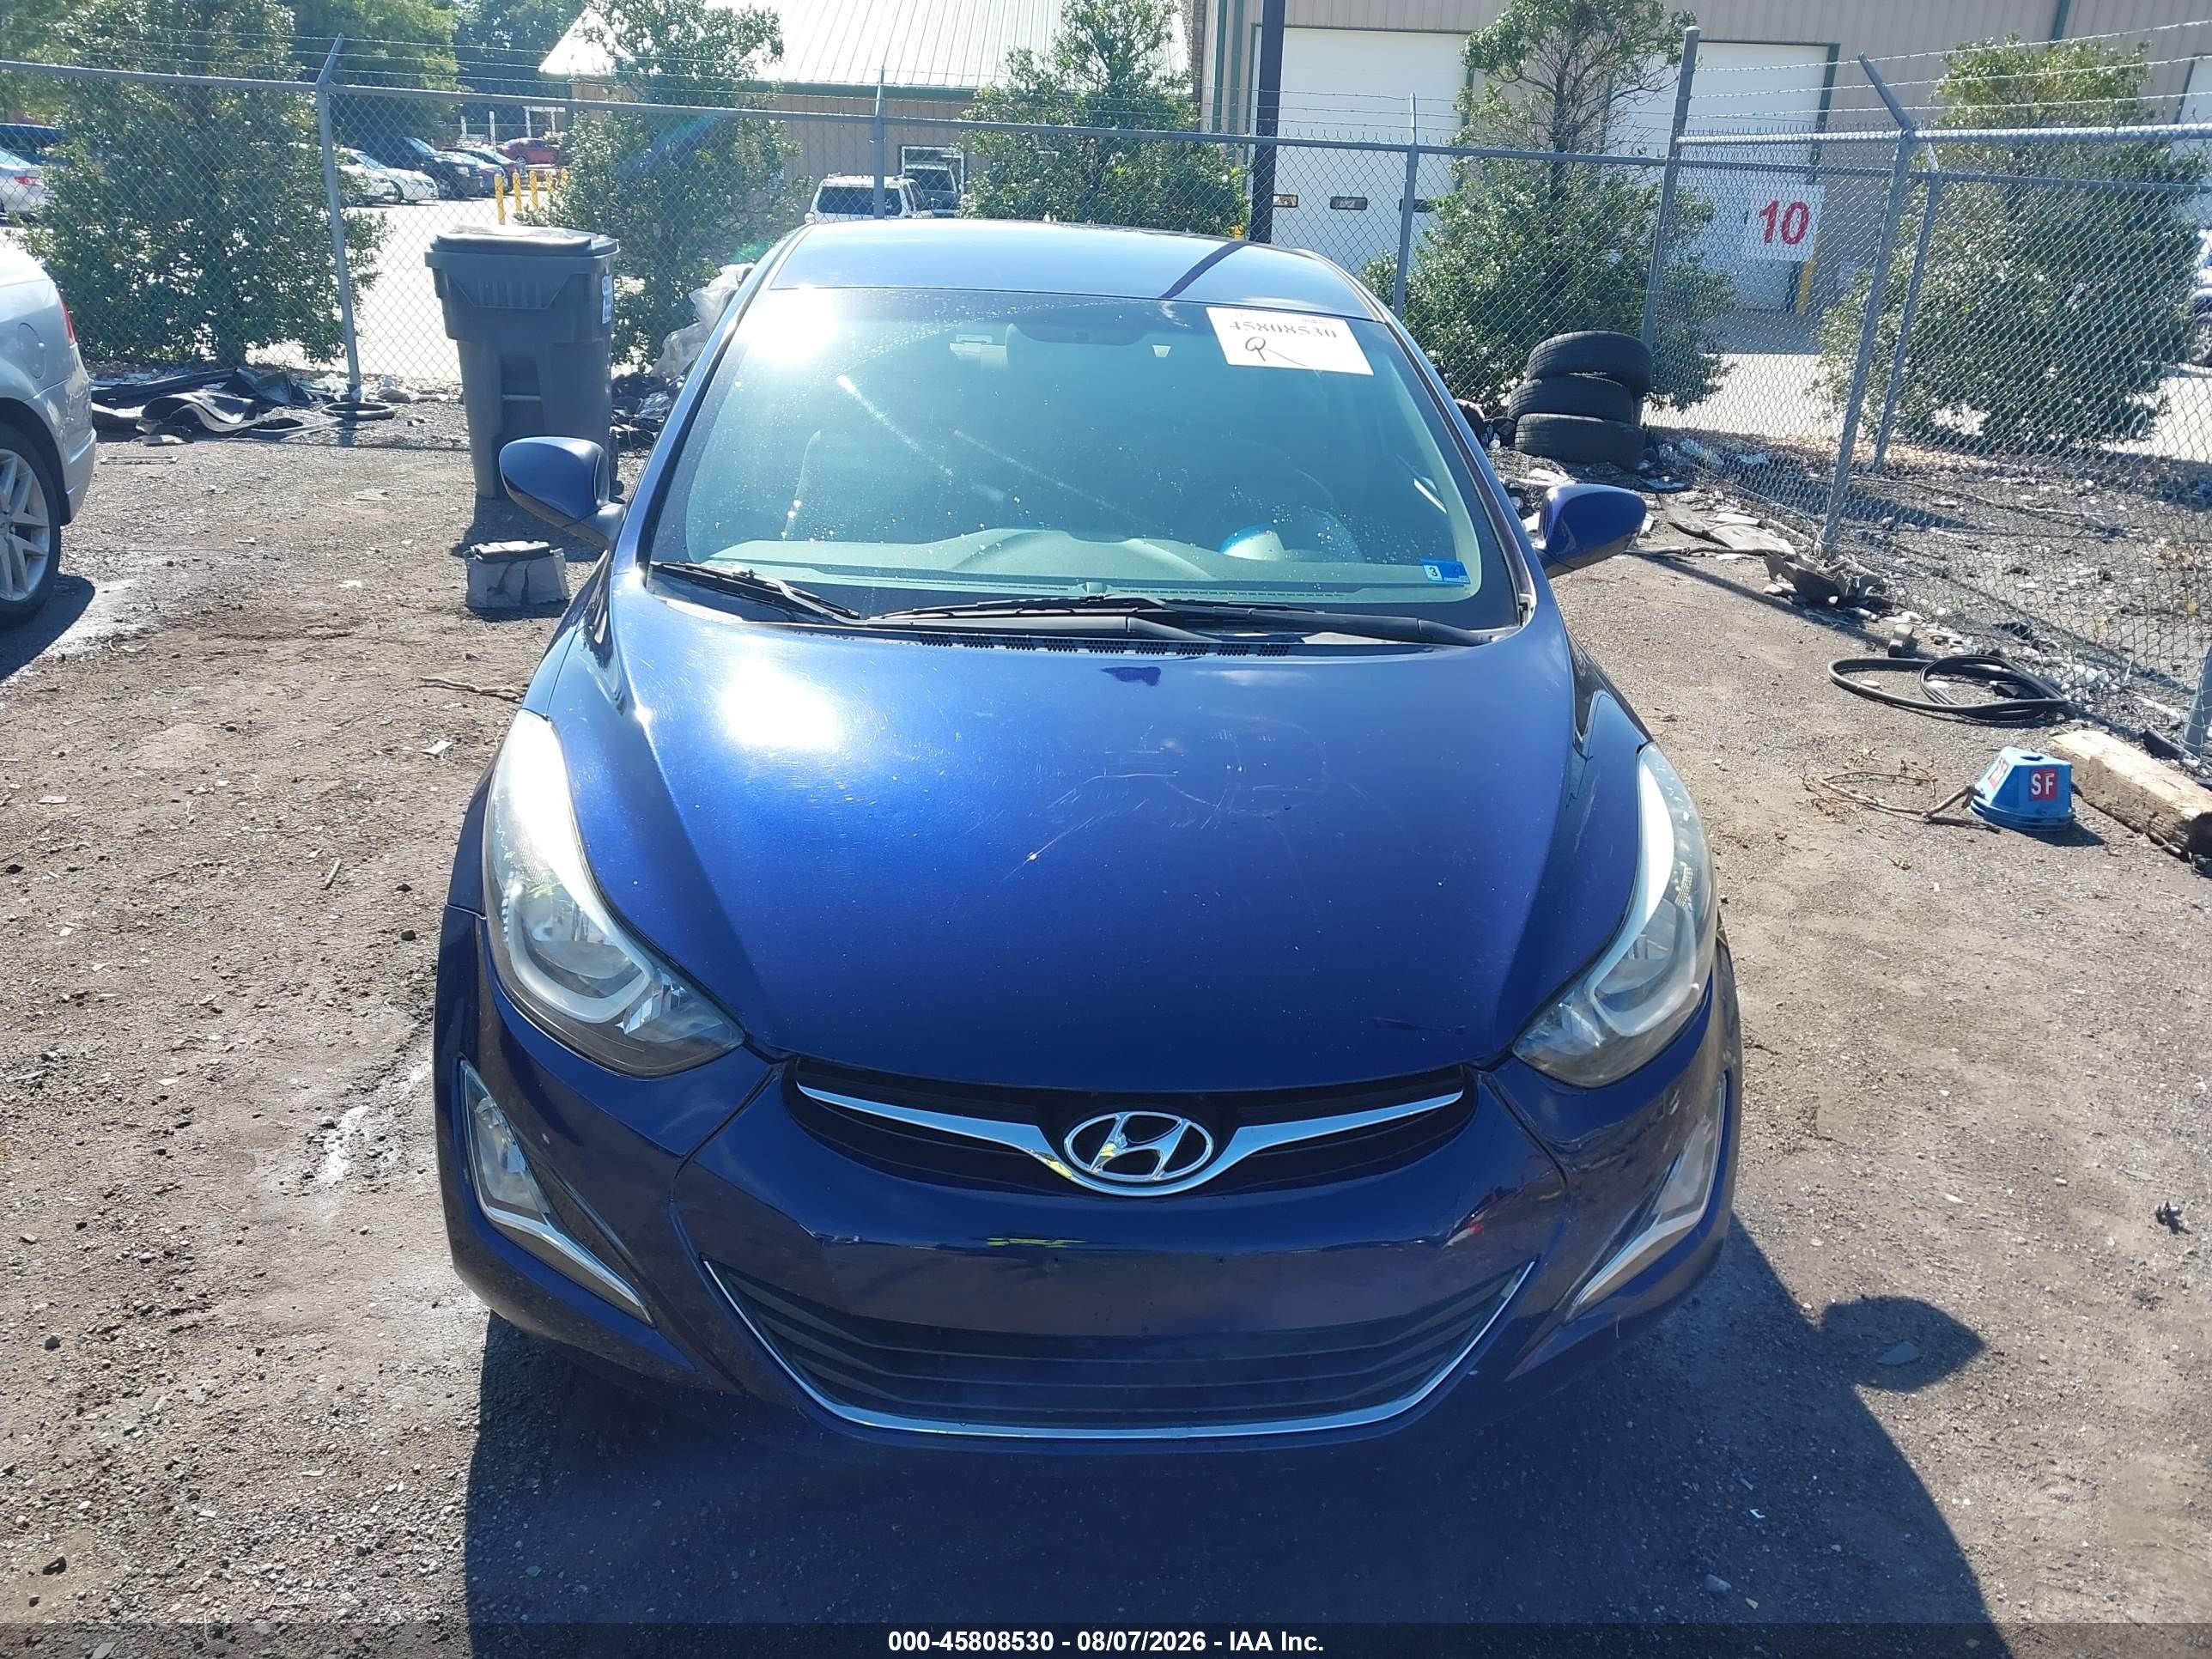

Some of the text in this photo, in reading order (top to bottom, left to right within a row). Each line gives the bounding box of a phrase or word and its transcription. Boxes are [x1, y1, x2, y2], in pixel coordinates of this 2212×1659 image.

[1759, 200, 1809, 245] 10
[1230, 321, 1338, 338] 45808530
[1429, 566, 1438, 577] 3
[2031, 773, 2055, 795] SF
